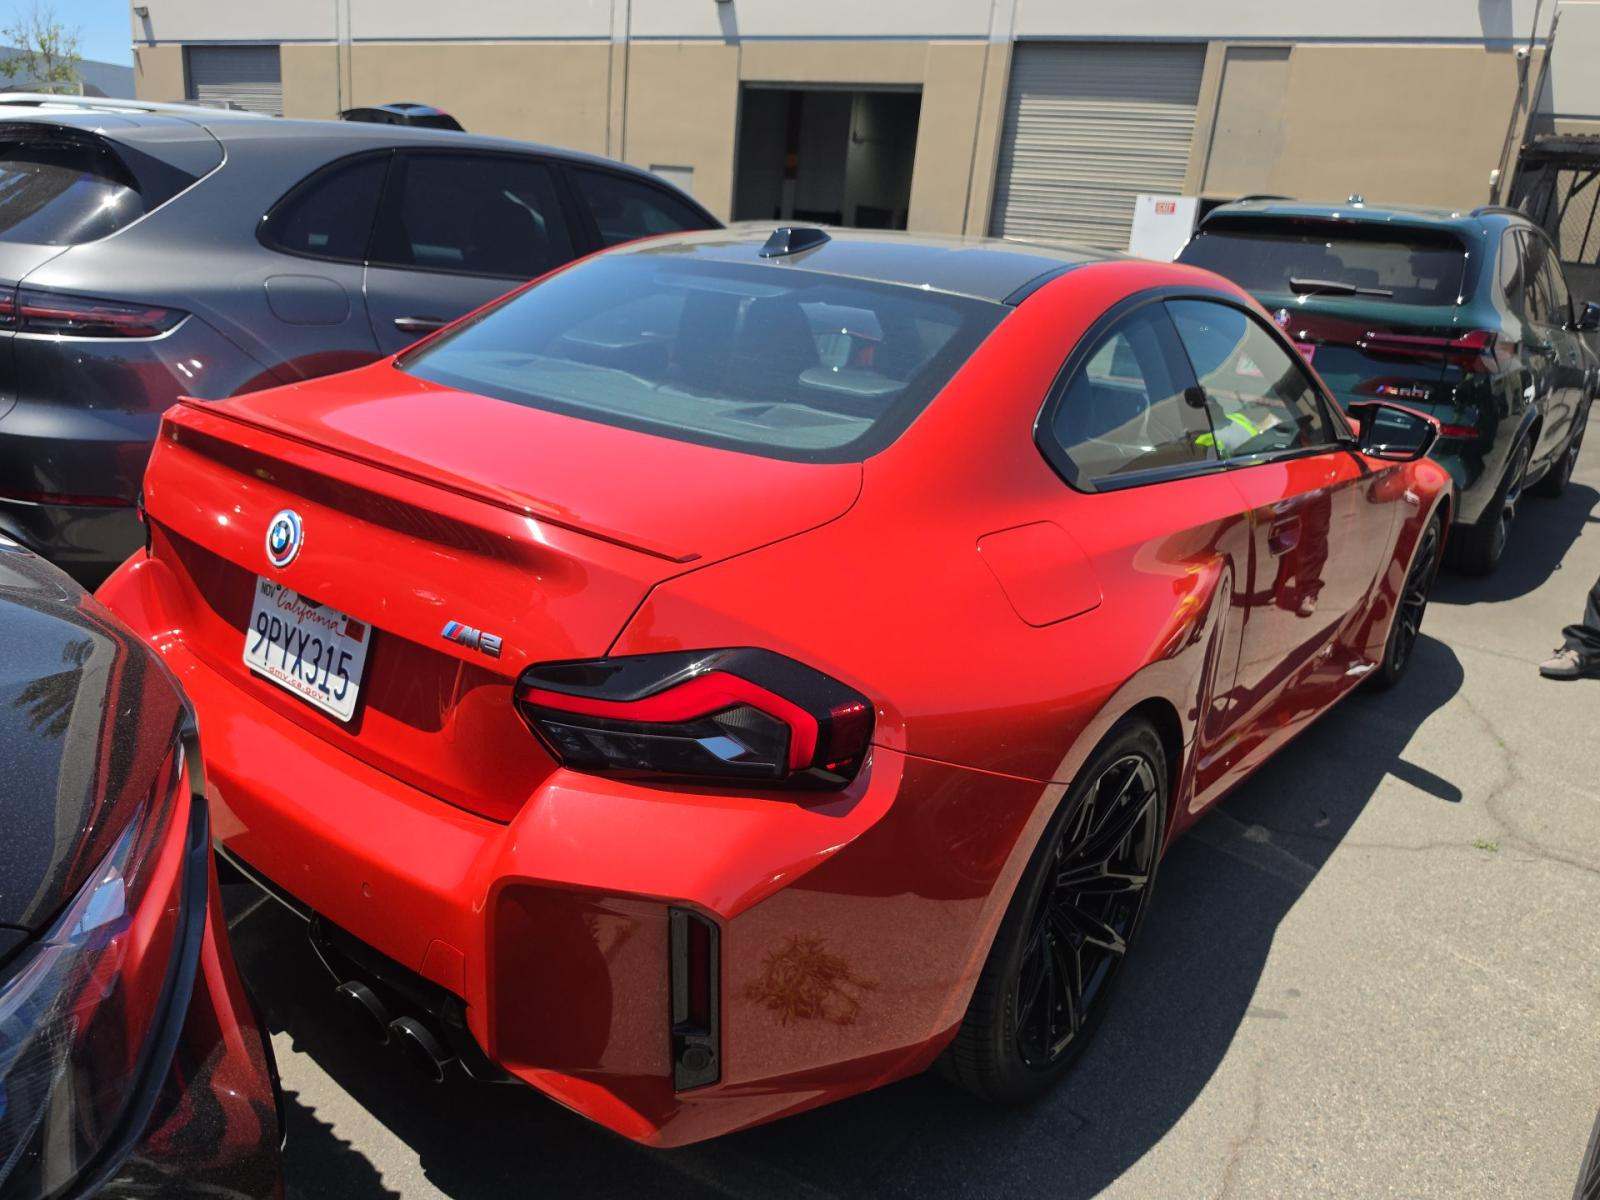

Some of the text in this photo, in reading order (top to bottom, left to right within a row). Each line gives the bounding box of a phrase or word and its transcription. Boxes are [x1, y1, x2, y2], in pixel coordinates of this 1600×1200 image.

[261, 581, 277, 599] NOV
[277, 586, 345, 637] California
[251, 611, 353, 701] 9PYX315
[457, 624, 503, 659] M2
[267, 665, 325, 702] dmv.ca.gov
